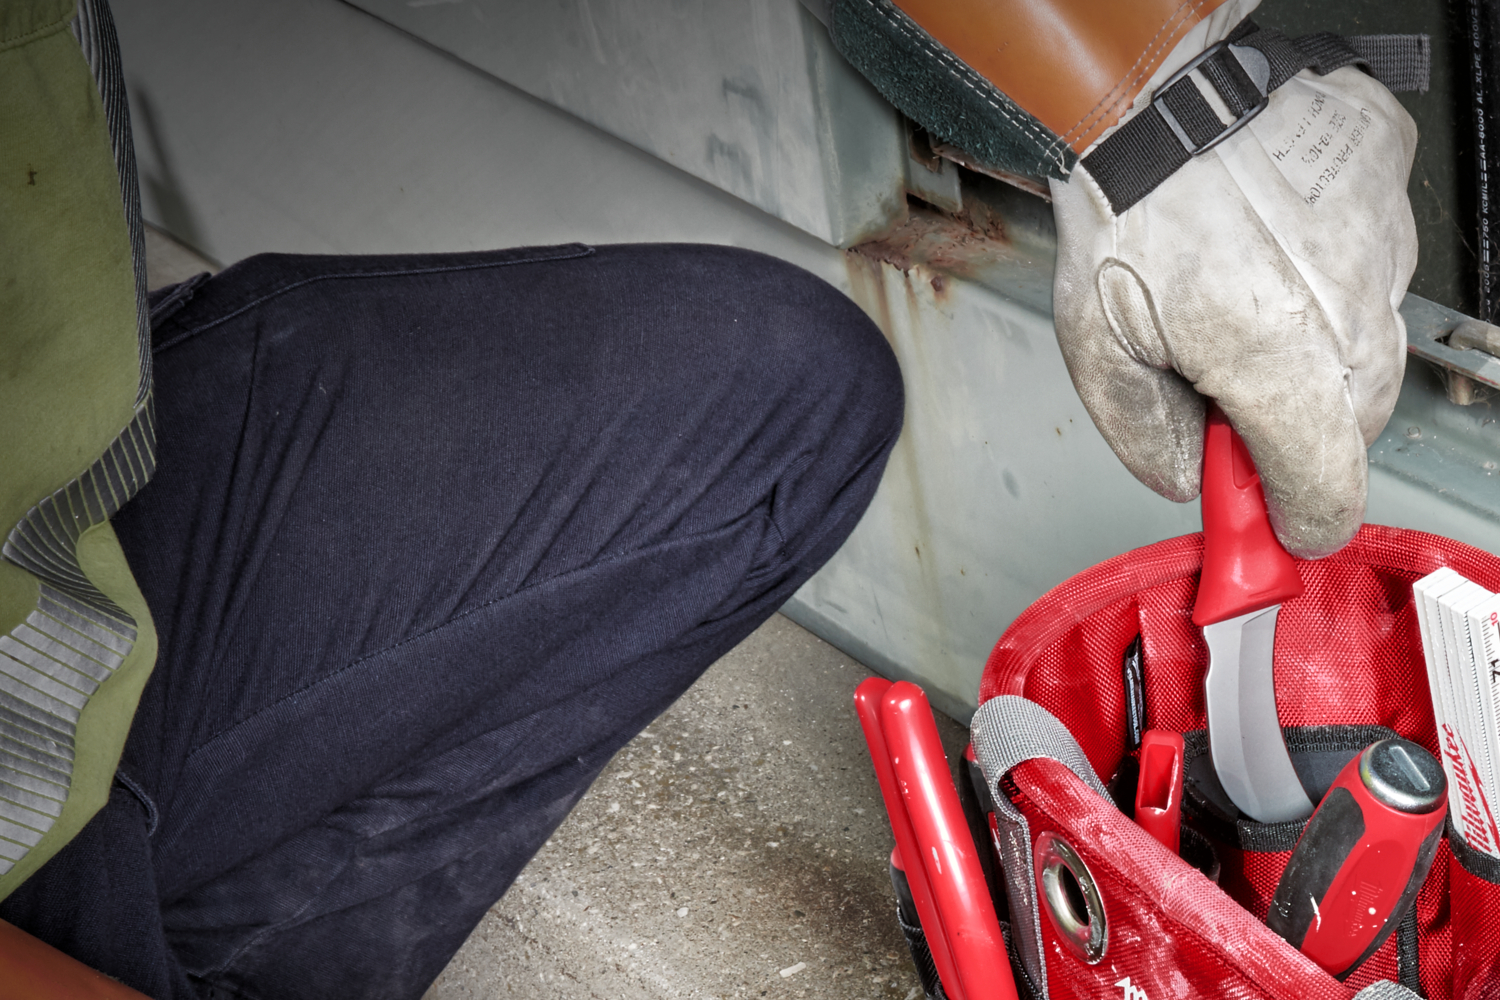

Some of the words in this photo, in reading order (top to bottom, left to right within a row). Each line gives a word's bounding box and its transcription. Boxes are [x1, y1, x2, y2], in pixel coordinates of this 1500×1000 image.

[1475, 53, 1483, 83] XLPE
[1476, 90, 1484, 104] AL
[1477, 109, 1487, 159] AA-8000
[1481, 182, 1489, 214] KCMIL
